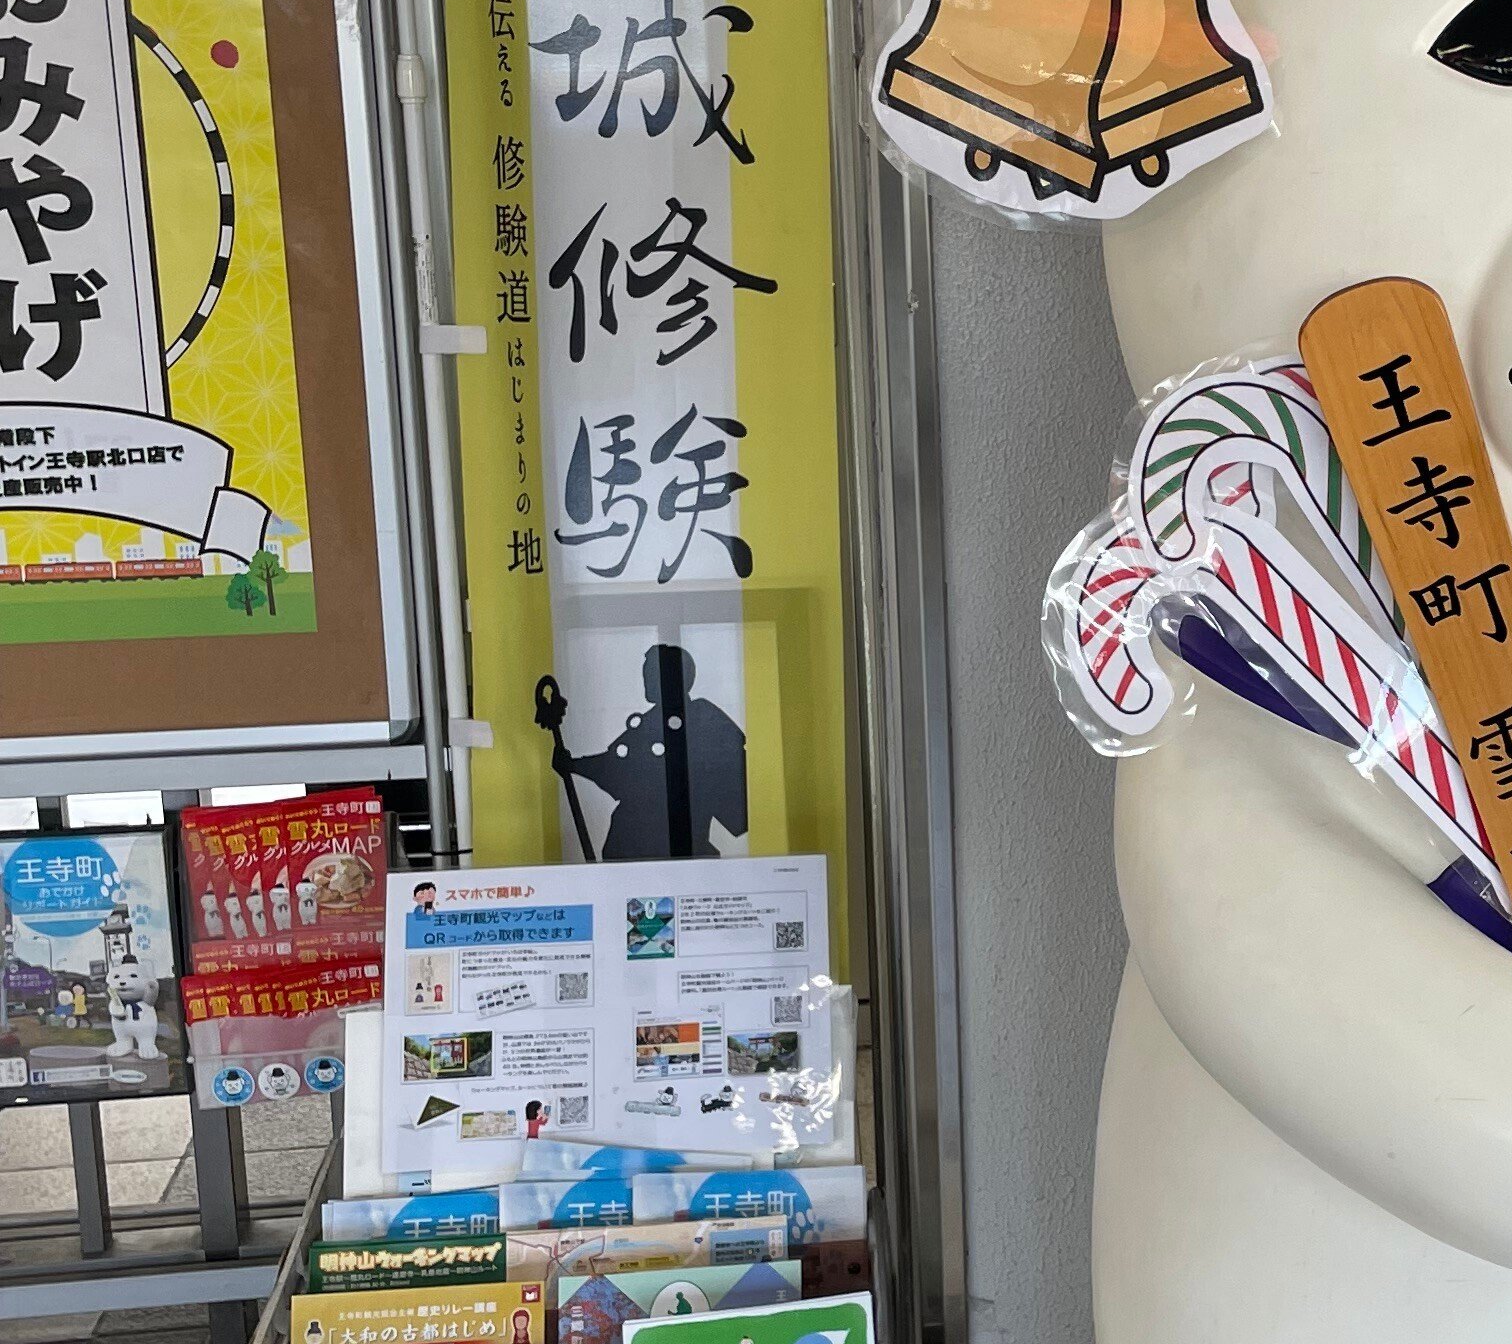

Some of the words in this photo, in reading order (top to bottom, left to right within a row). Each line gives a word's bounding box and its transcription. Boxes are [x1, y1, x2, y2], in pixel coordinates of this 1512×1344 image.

[1358, 353, 1511, 645] 王寺町
[15, 856, 104, 883] 王寺町
